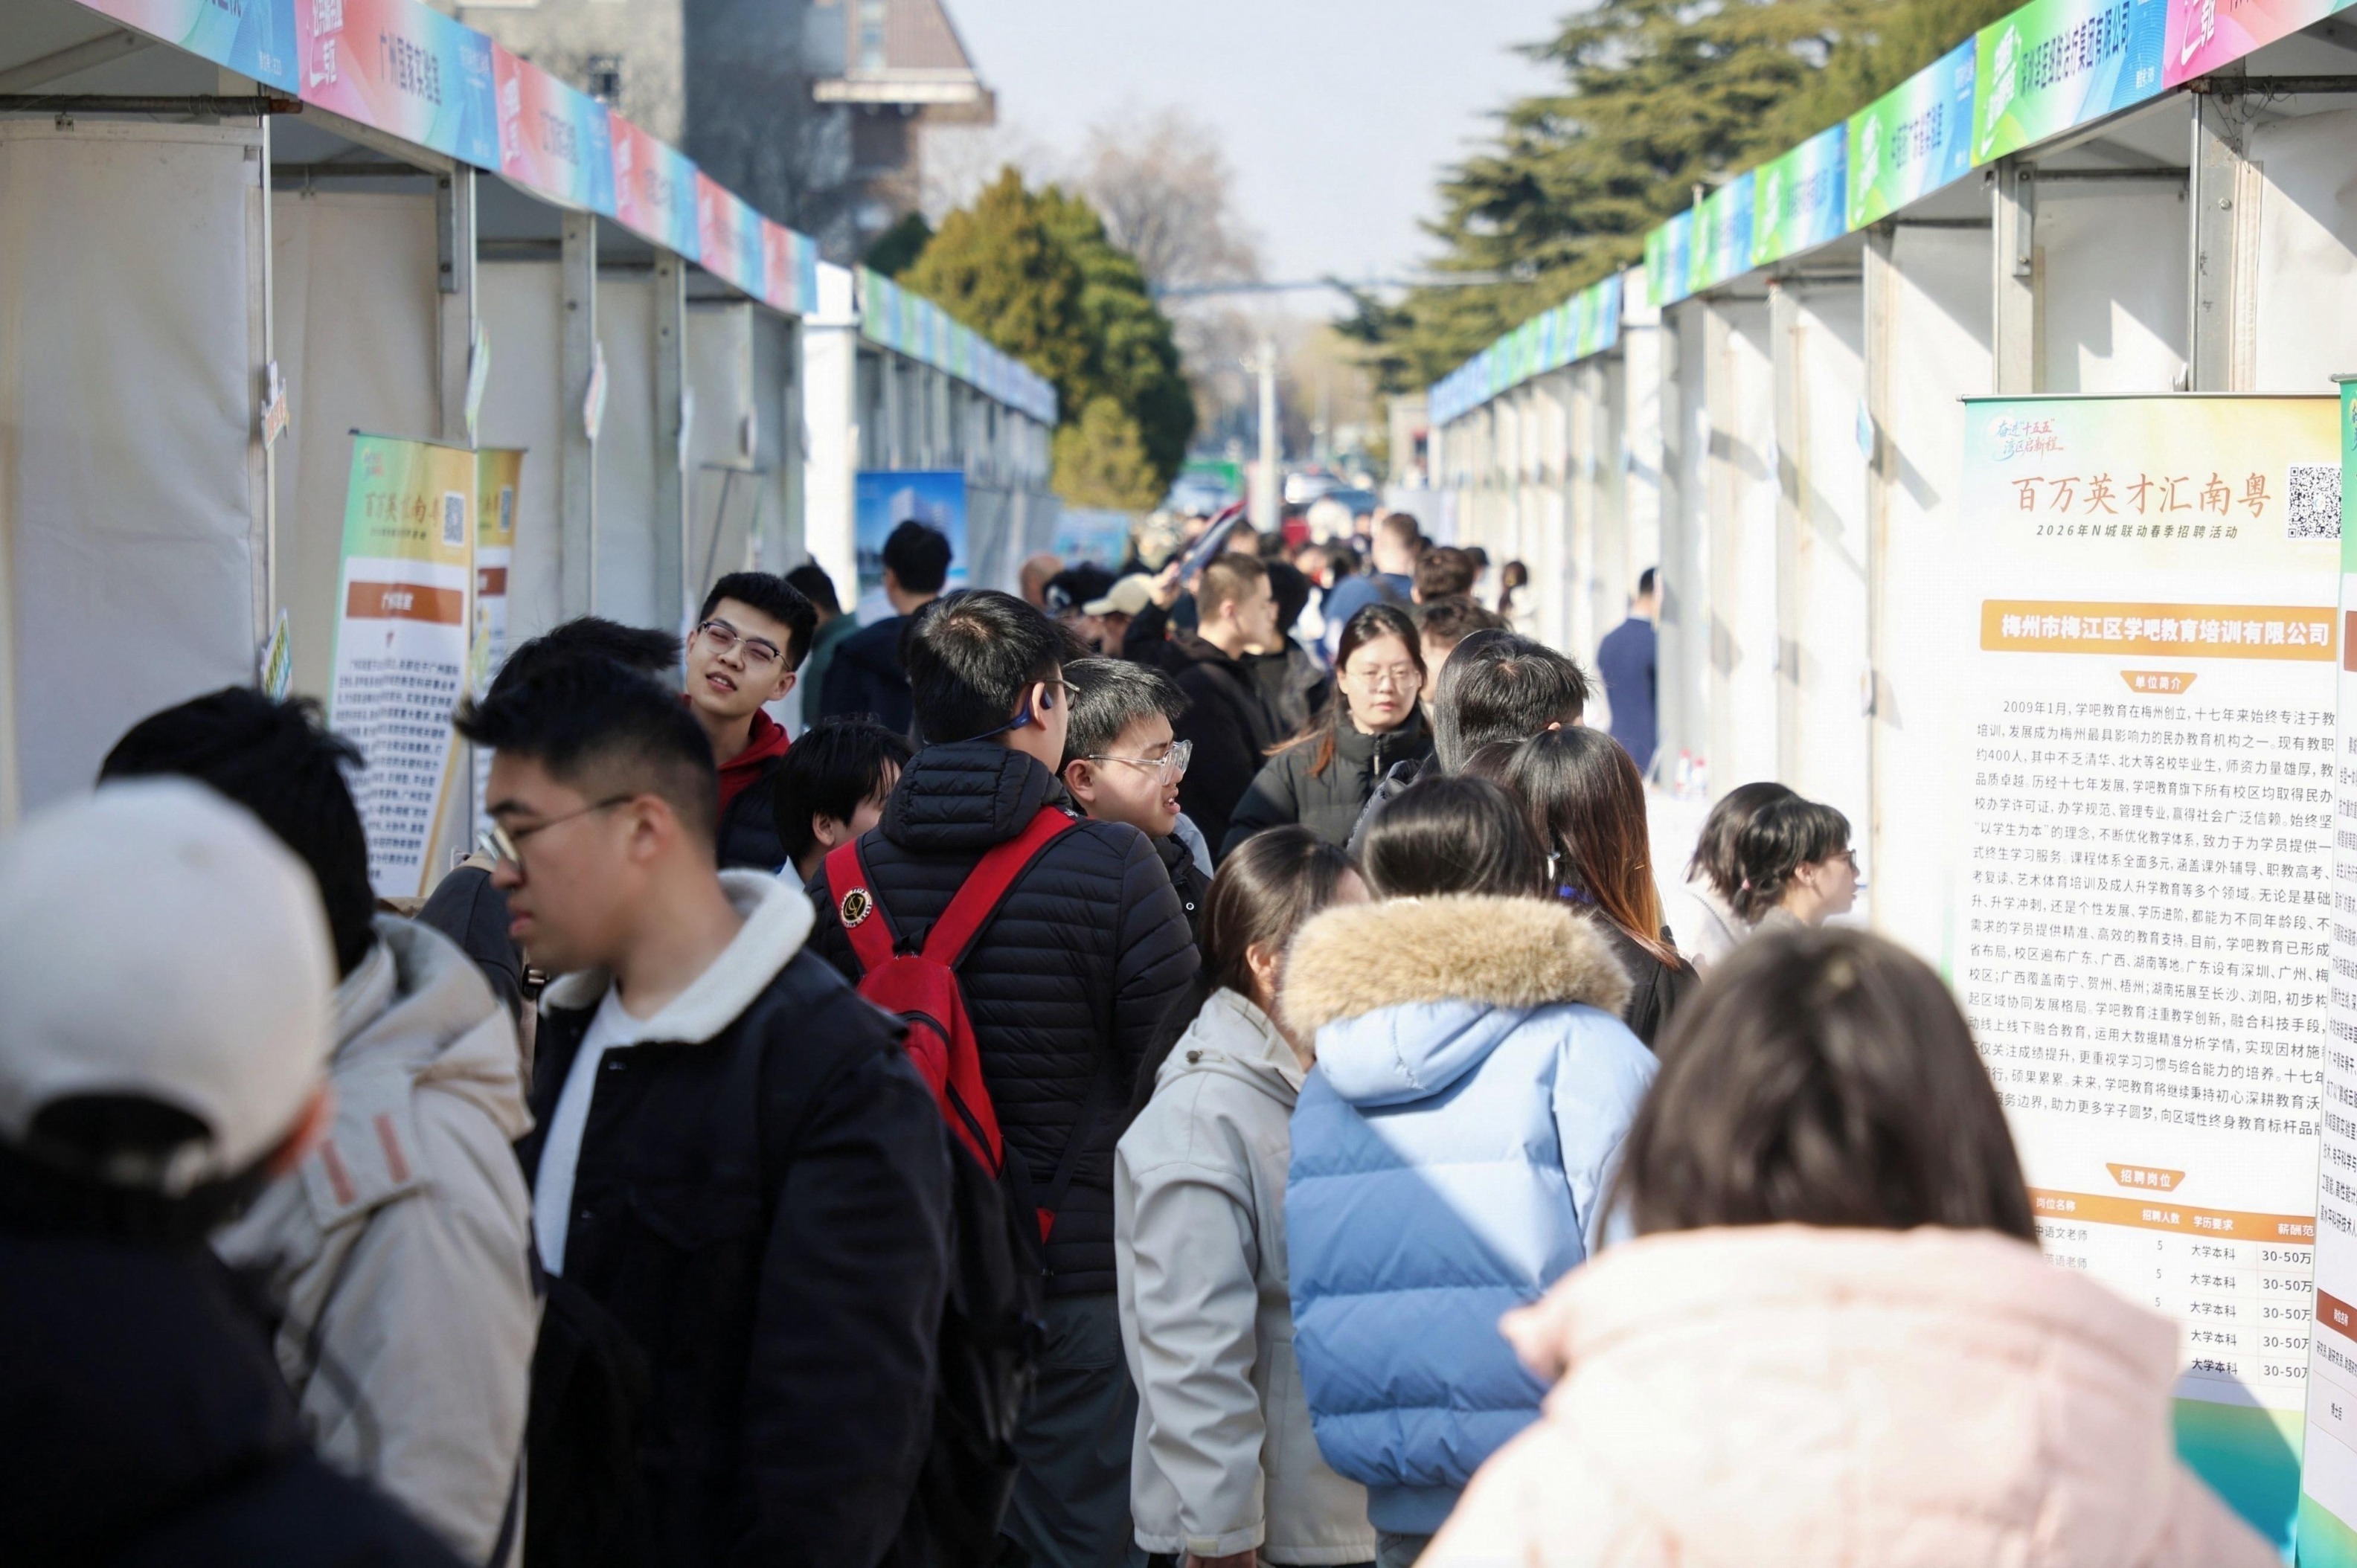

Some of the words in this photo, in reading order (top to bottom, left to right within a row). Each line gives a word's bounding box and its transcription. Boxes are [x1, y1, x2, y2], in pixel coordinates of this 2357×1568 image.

[2010, 472, 2271, 518] 百万英才汇南粤
[2036, 523, 2238, 539] 2026年N城联动春季招聘活动
[2001, 614, 2329, 646] 梅州市梅江区学吧教育培训有限公司
[2135, 675, 2181, 691] 单位简介
[2120, 1169, 2172, 1188] 招聘岗位
[2036, 1198, 2077, 1212] 岗位名称
[2142, 1209, 2181, 1225] 招聘人数
[2193, 1215, 2233, 1232] 学历要求
[2157, 1241, 2163, 1250] 5
[2190, 1244, 2236, 1261] 大学本科
[2262, 1250, 2312, 1265] 30-50万
[2156, 1269, 2162, 1279] 5
[2190, 1273, 2236, 1289] 大学本科
[2263, 1278, 2312, 1293] 30-50万
[2155, 1297, 2161, 1307] 5
[2190, 1301, 2236, 1317] 大学本科
[2190, 1329, 2237, 1346] 大学本科
[2191, 1357, 2238, 1375] 大学本科
